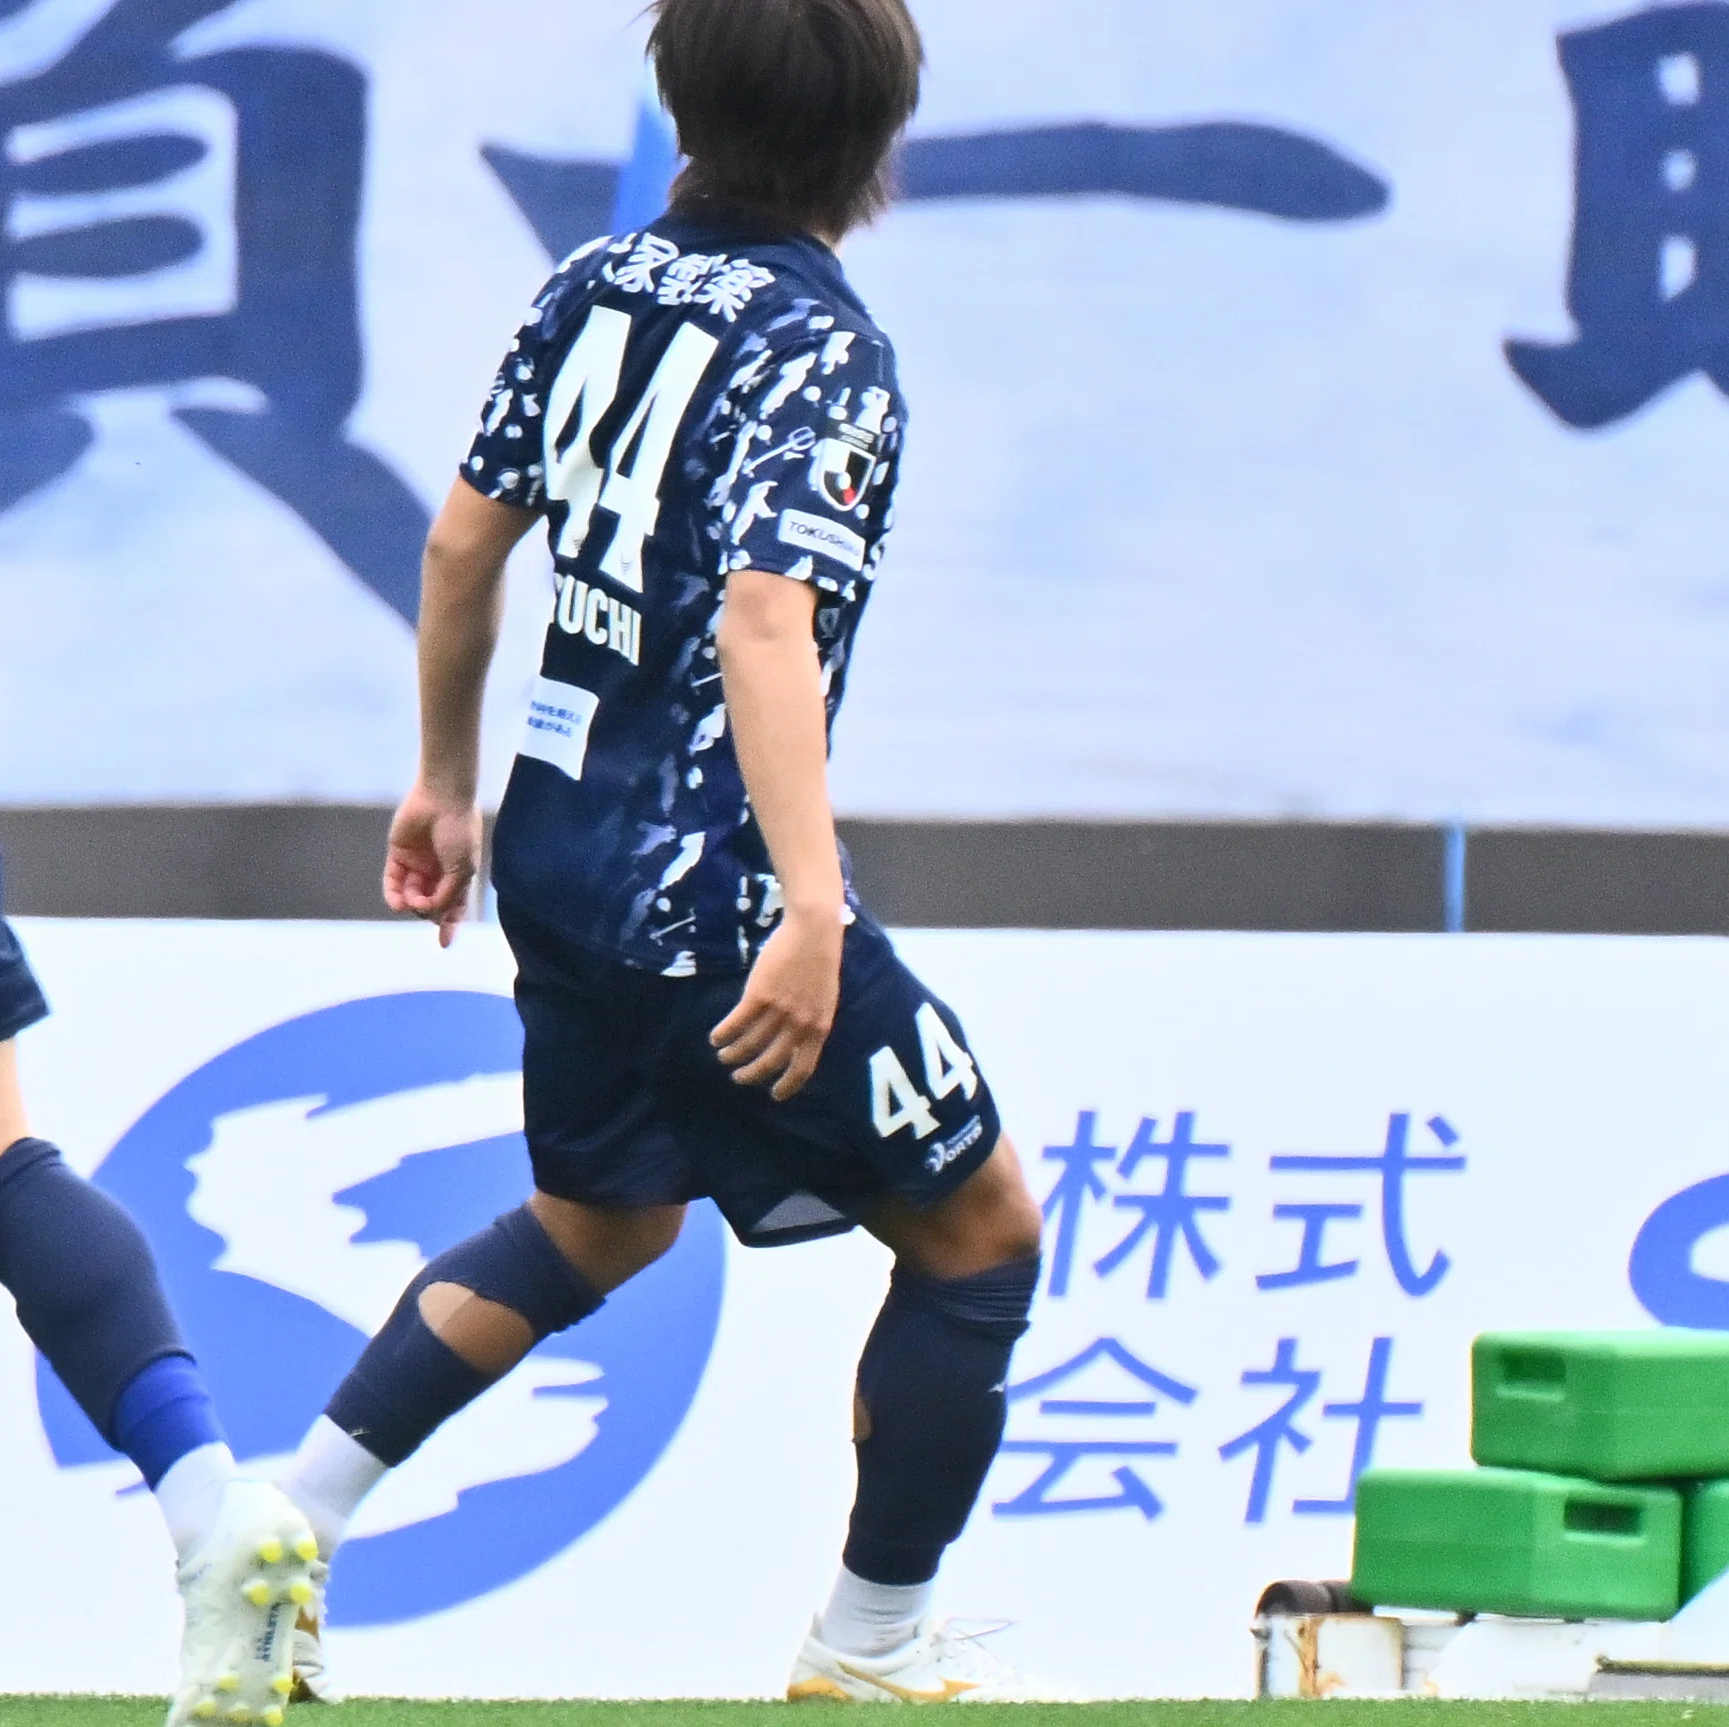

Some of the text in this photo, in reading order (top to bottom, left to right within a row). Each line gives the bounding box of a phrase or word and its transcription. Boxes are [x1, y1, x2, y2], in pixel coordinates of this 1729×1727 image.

[543, 304, 720, 594] 44
[869, 1002, 977, 1140] 44
[1040, 1110, 1468, 1300] 株式
[990, 1335, 1425, 1525] 会社
